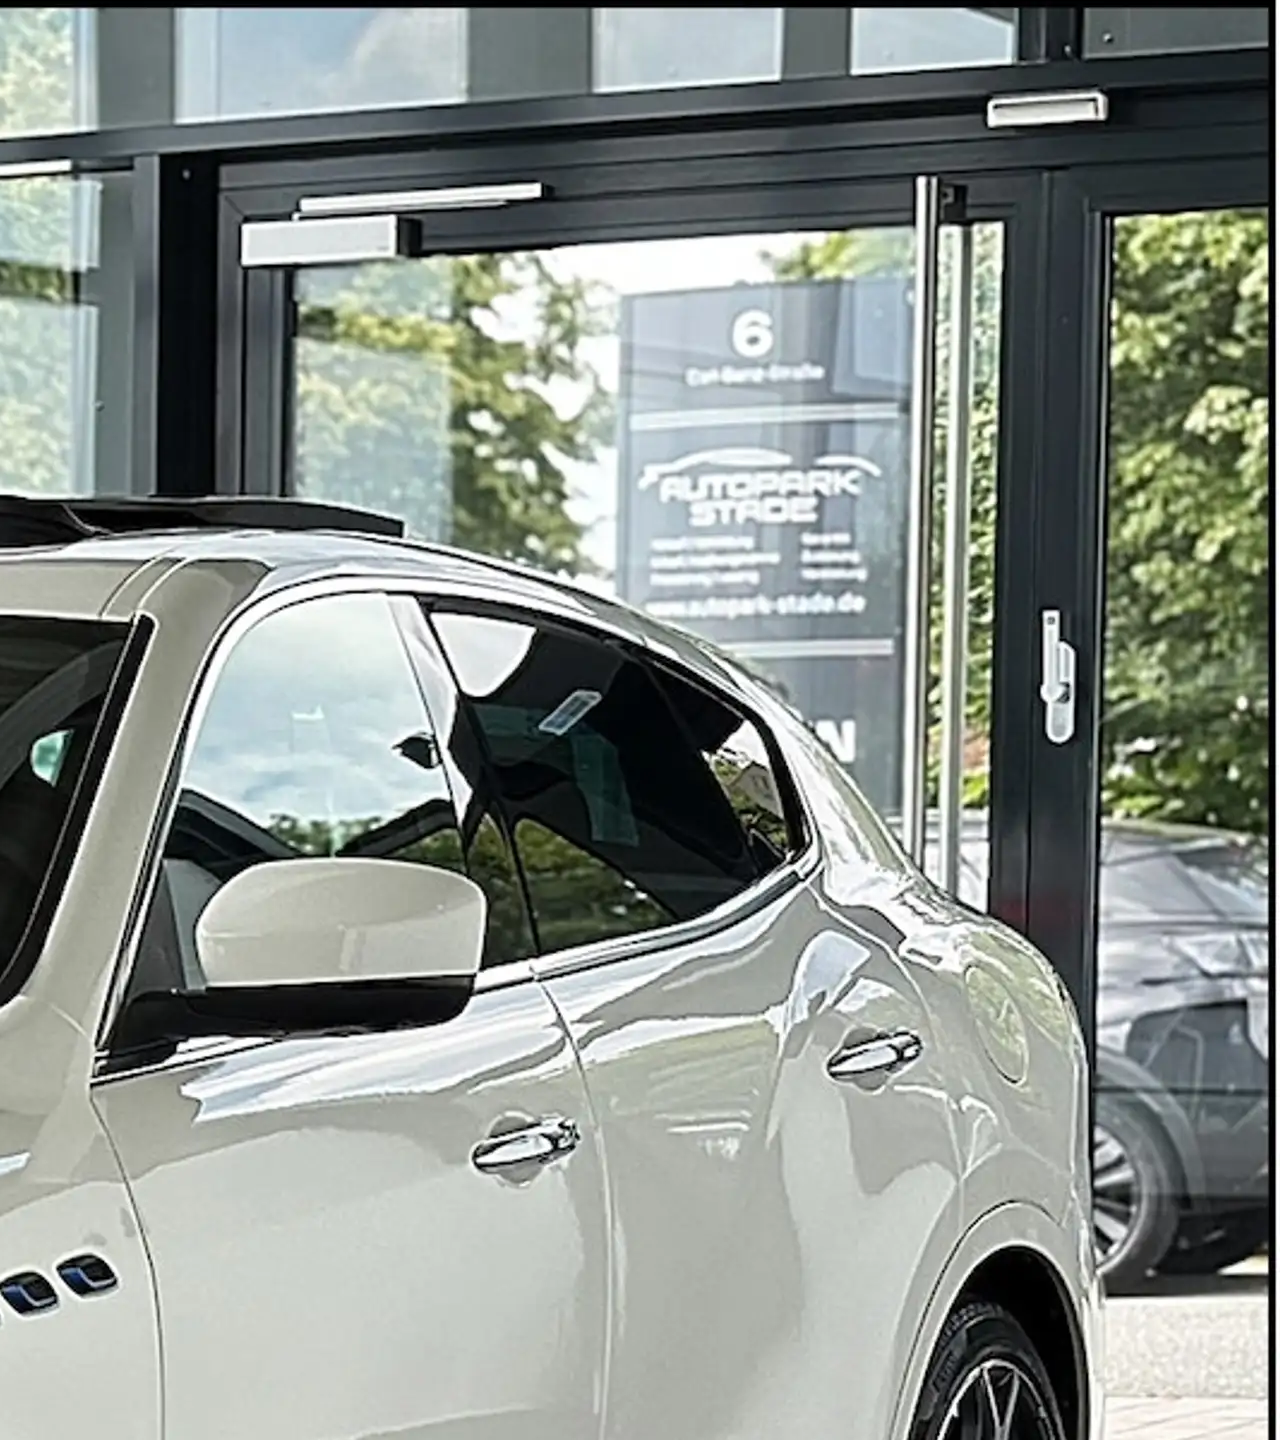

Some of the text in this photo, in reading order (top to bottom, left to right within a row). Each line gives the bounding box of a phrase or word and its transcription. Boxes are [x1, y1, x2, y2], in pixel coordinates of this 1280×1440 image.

[732, 309, 774, 358] 6
[660, 469, 863, 503] AUTOPARK
[689, 496, 819, 526] STADE
